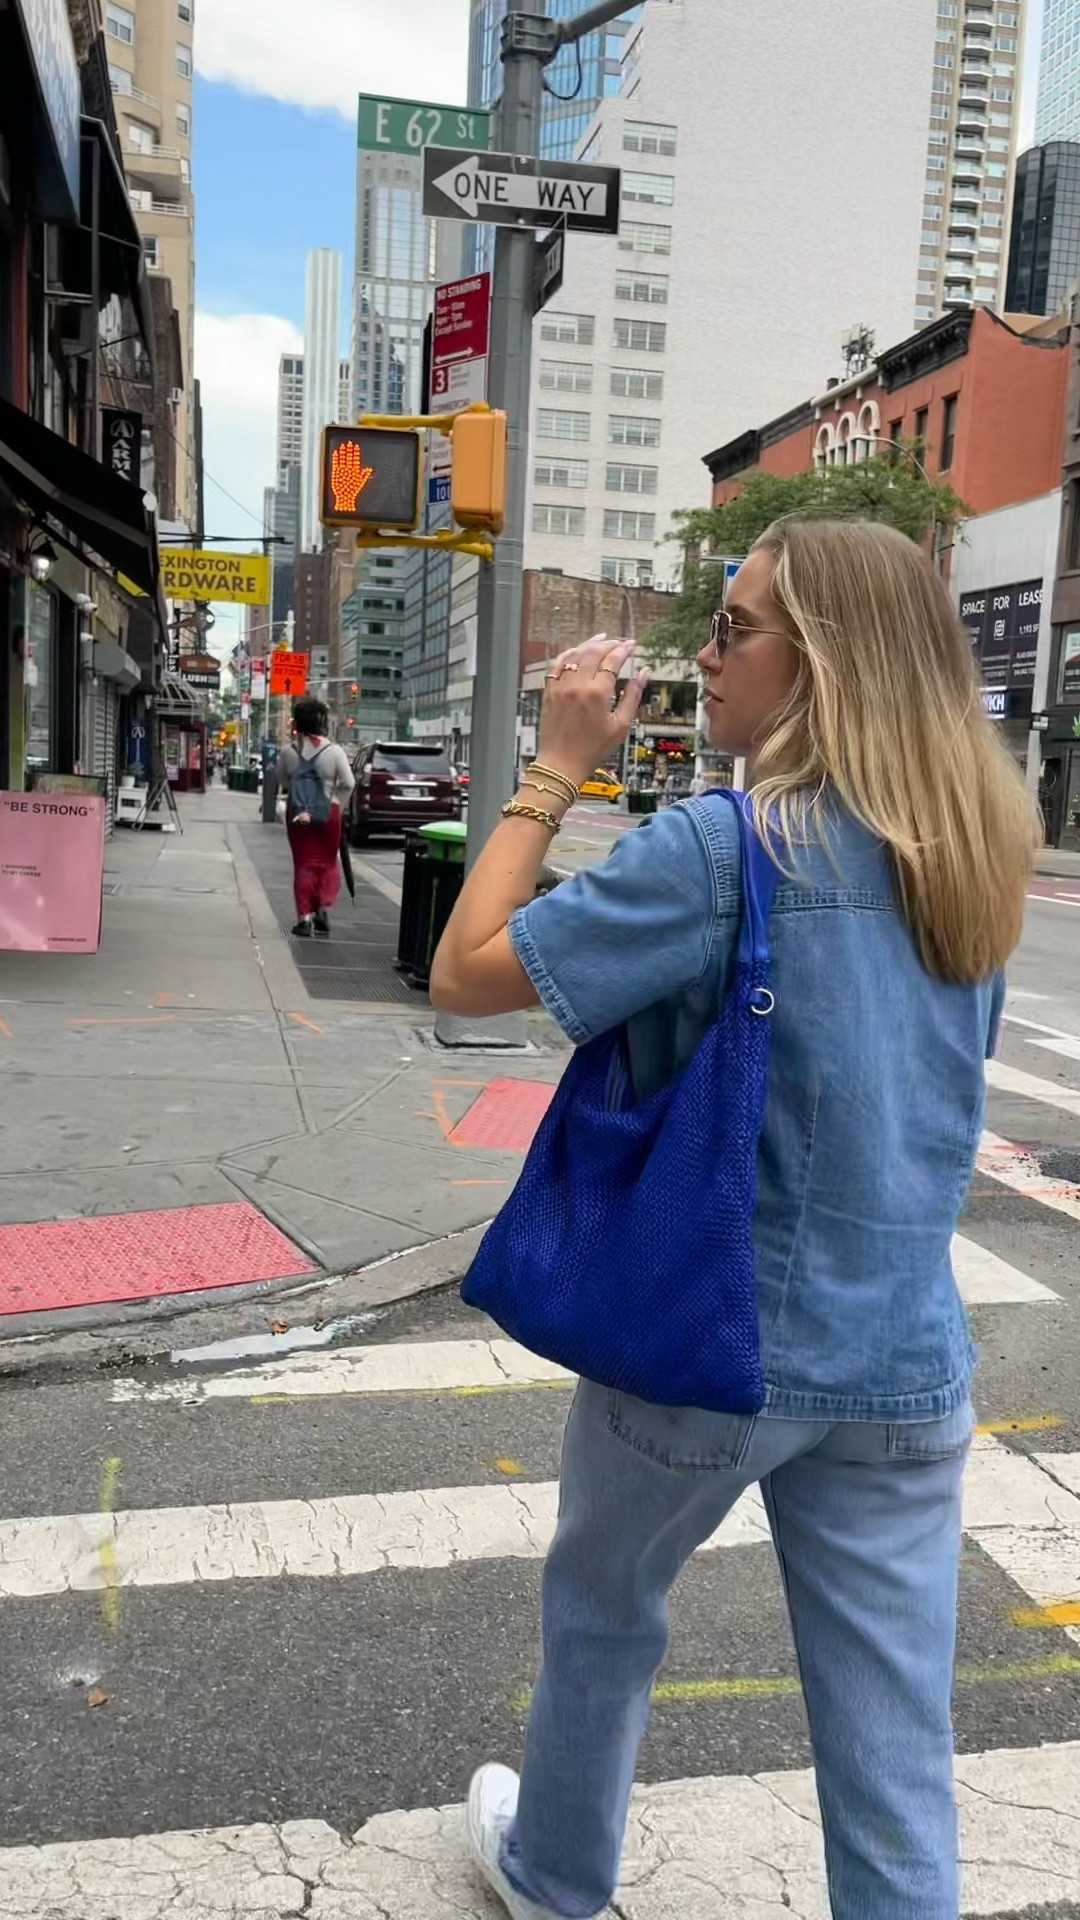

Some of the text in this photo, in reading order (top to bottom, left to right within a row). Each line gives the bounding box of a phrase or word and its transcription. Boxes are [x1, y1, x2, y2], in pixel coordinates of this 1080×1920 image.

[375, 103, 475, 148] E 62 St
[454, 171, 595, 212] ONE WAY
[448, 278, 482, 298] STANDING
[434, 369, 446, 392] 3
[961, 599, 986, 617] SPACE
[993, 595, 1011, 611] FOR
[182, 673, 208, 683] LUSH
